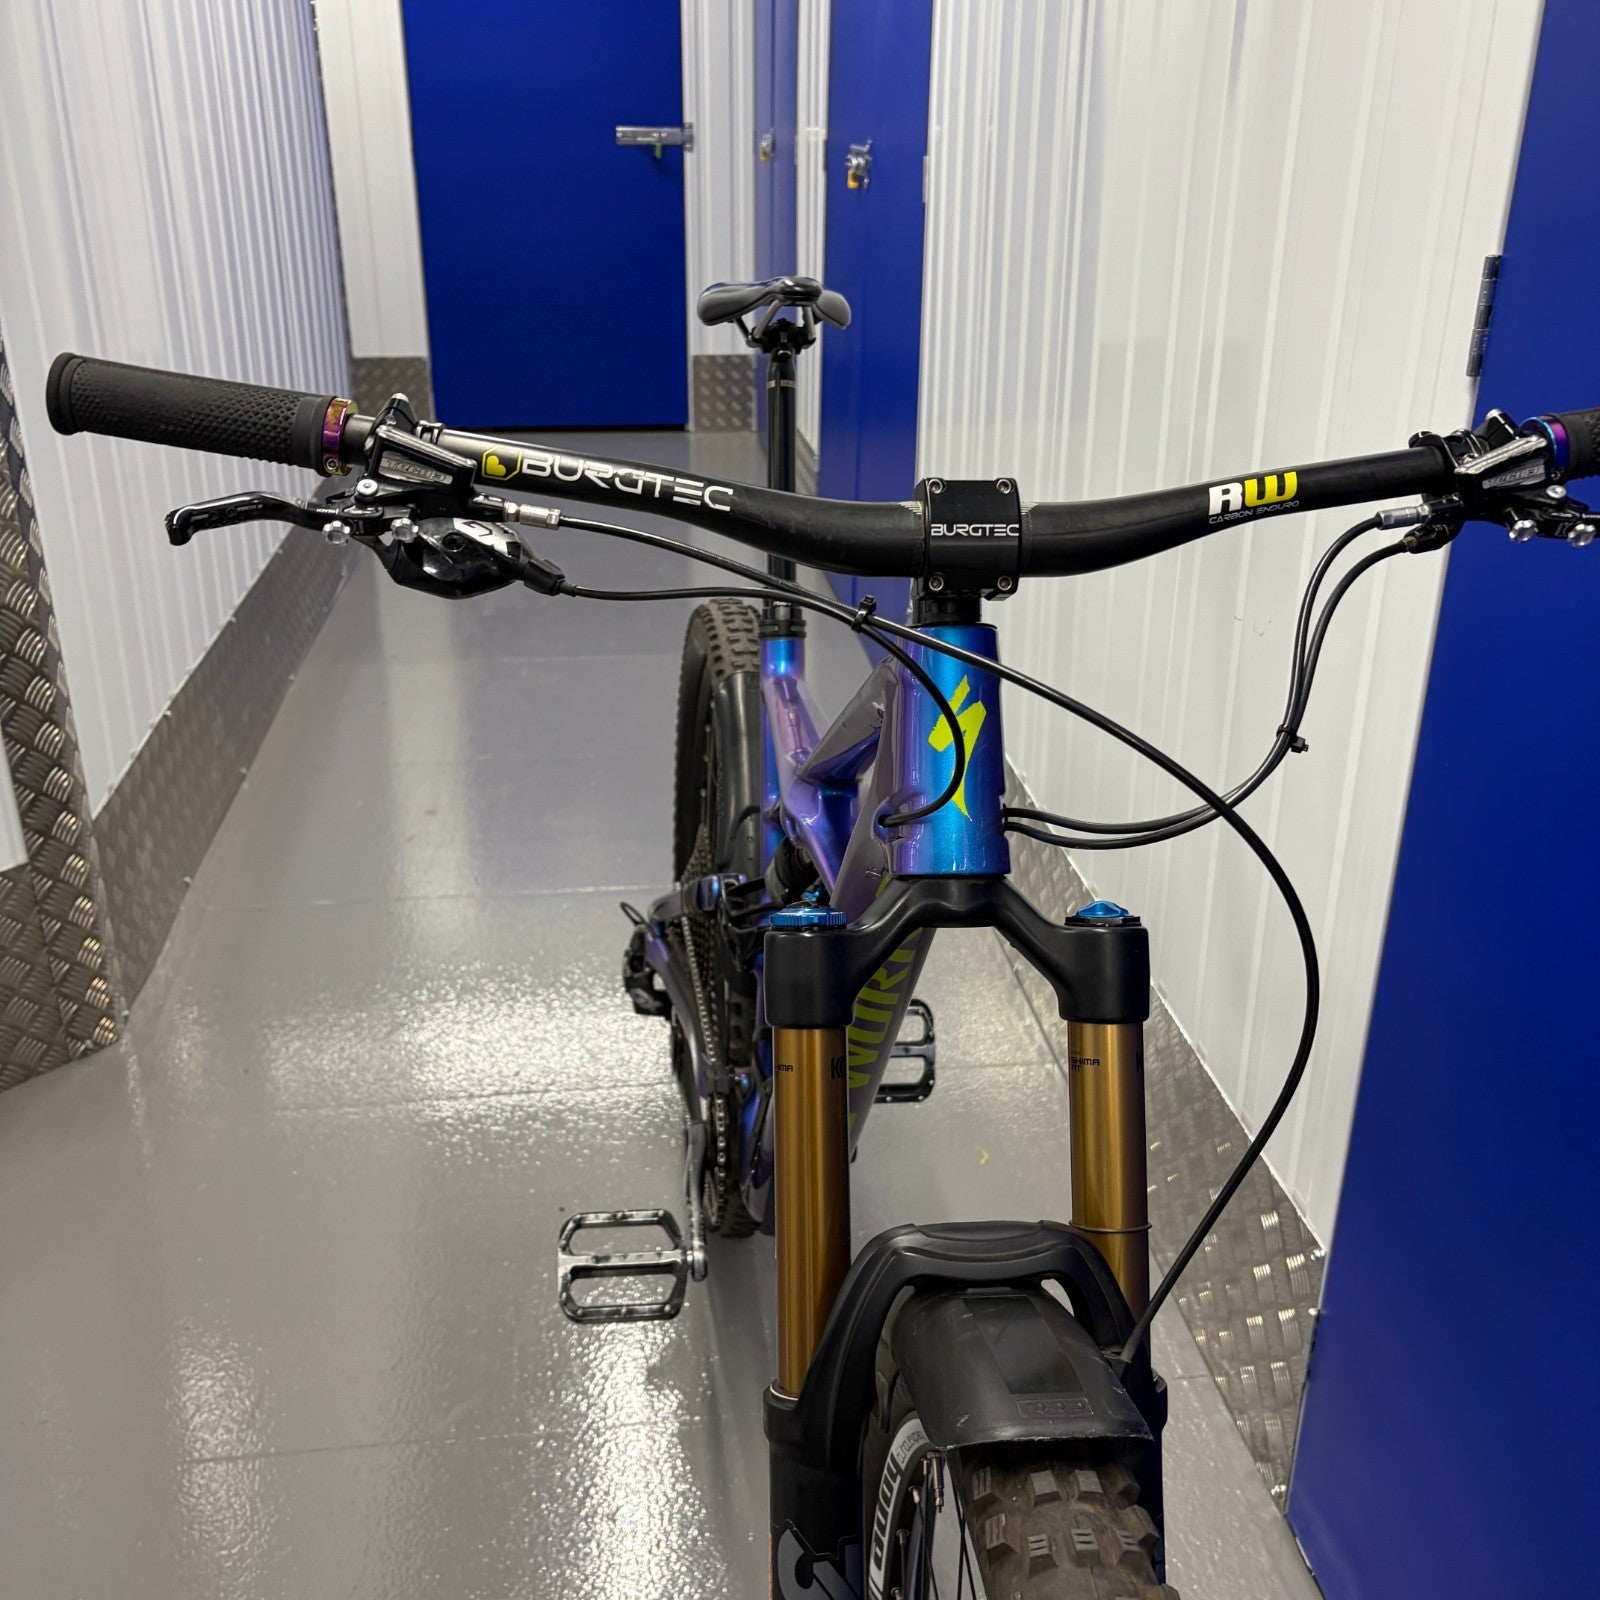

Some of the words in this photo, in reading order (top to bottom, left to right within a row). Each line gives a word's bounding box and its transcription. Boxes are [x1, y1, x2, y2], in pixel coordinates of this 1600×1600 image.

[522, 451, 734, 512] BURGTEC
[1209, 472, 1298, 516] RW
[1208, 508, 1253, 525] CARBON
[1256, 500, 1300, 515] ENDURO
[930, 523, 1020, 537] BURGTEC
